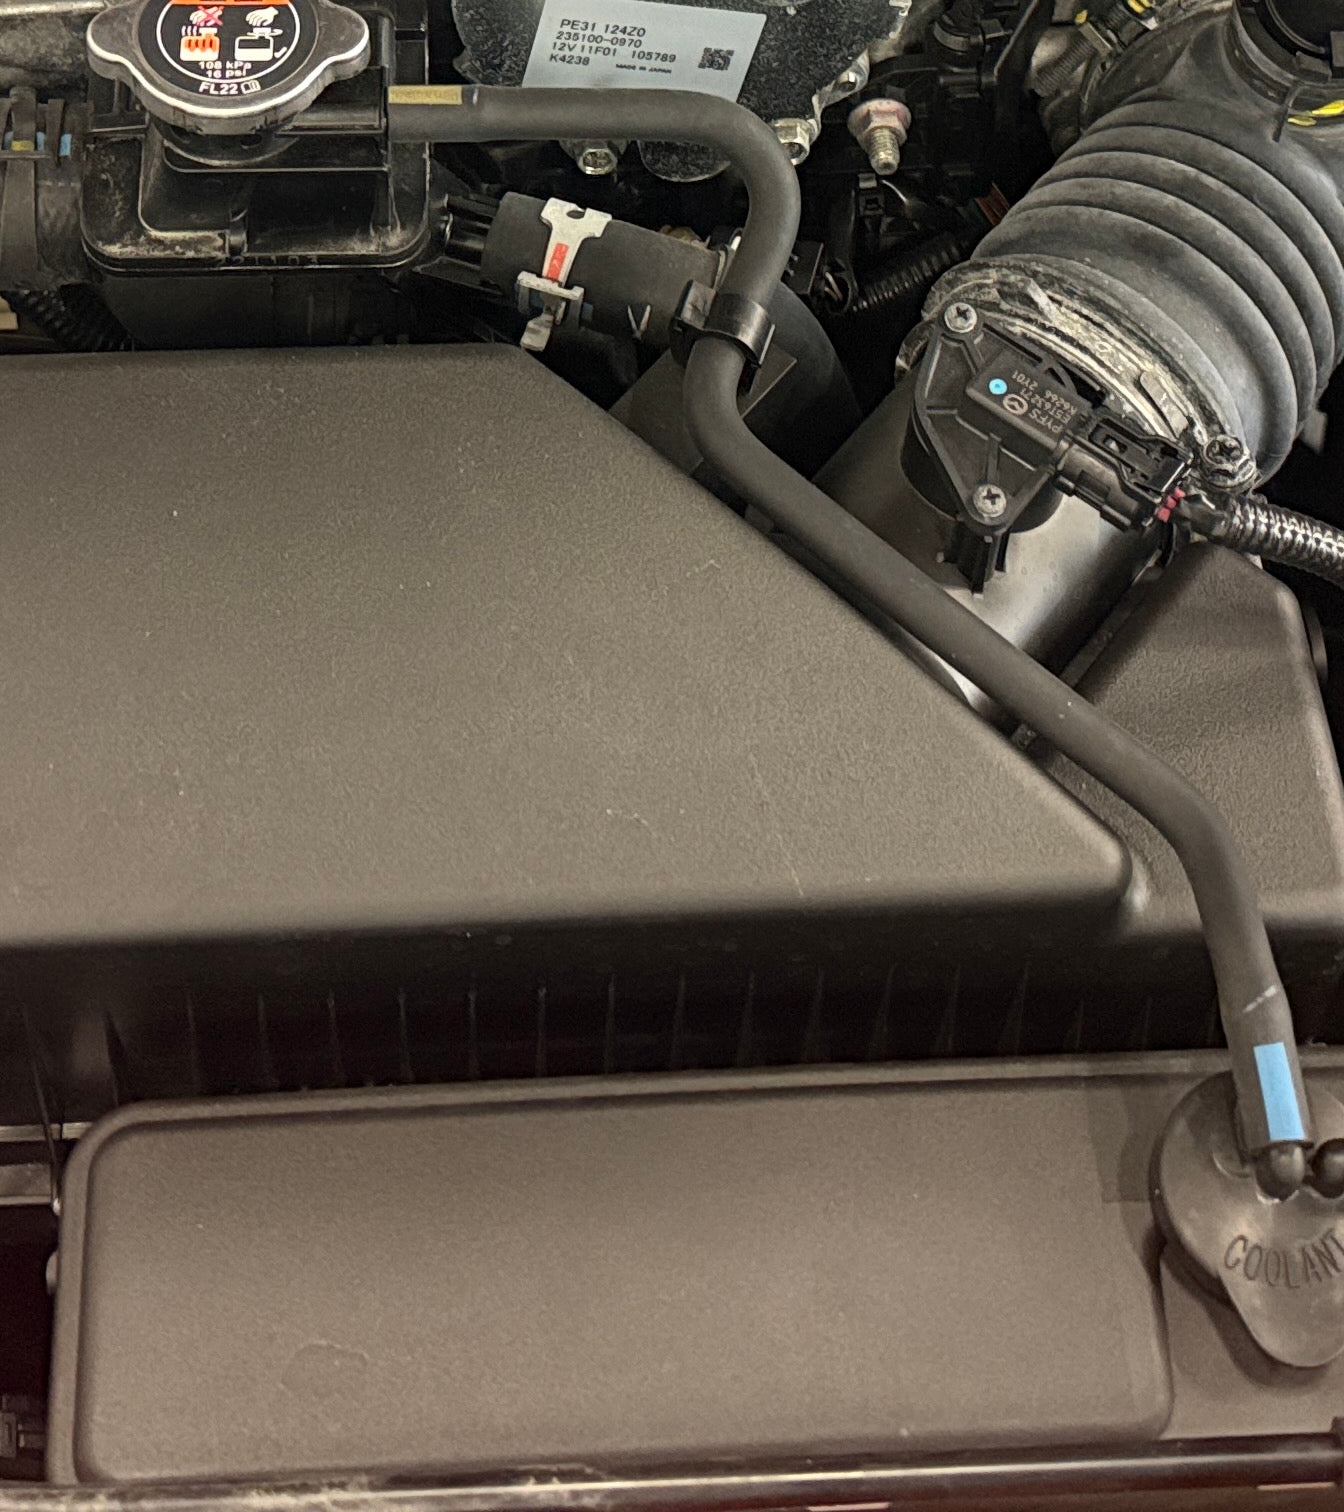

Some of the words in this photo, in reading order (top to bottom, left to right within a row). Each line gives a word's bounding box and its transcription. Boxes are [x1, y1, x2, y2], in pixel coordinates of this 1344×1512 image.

[560, 18, 597, 32] PE31
[604, 24, 646, 38] 124Z0
[556, 31, 642, 49] 235100-0970
[552, 41, 577, 53] 12V
[631, 50, 677, 63] 105789
[199, 60, 222, 70] 108
[549, 53, 590, 66] K4238
[206, 69, 222, 78] 16
[198, 81, 239, 95] FL22
